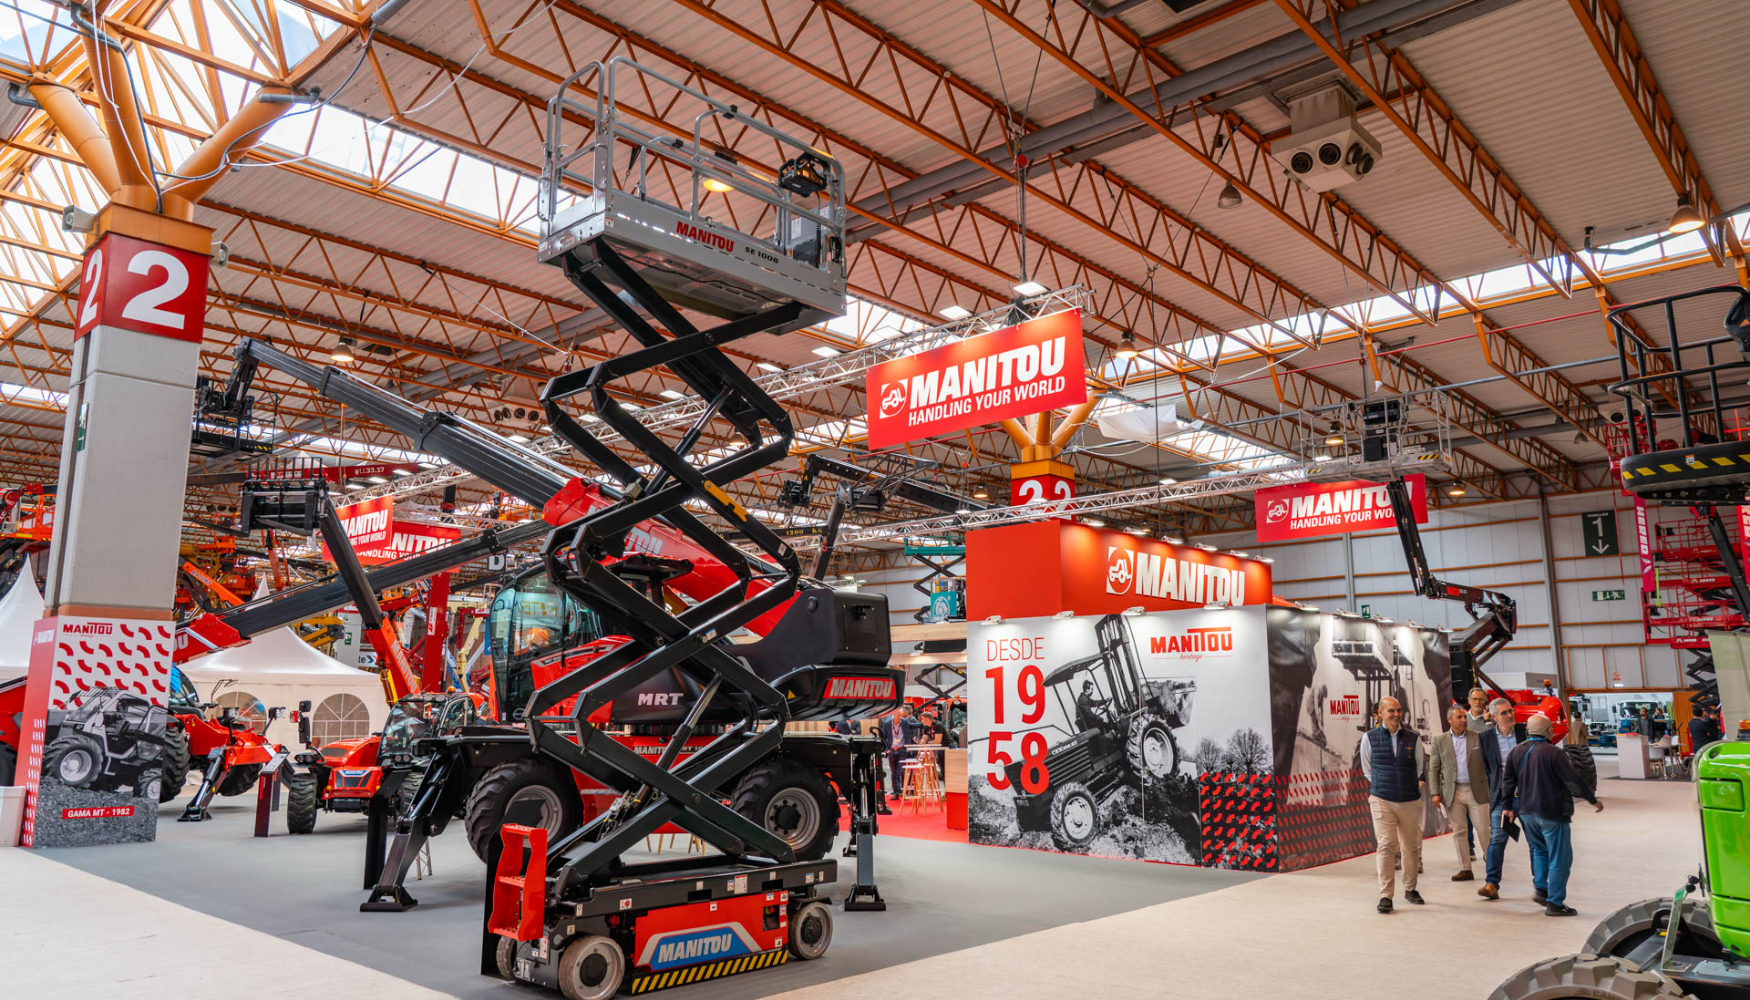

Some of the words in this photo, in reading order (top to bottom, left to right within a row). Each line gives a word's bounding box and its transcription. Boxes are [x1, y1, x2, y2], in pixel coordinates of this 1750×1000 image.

[676, 221, 734, 253] MANITOU
[745, 246, 756, 256] SE
[757, 251, 779, 264] 1008
[80, 249, 103, 329] 2
[121, 250, 190, 330] 2
[909, 336, 1066, 410] MANITOU
[908, 397, 972, 427] HANDLING
[975, 389, 1011, 411] YOUR
[1014, 376, 1066, 401] WORLD
[1290, 513, 1342, 530] HANDLING
[1344, 511, 1372, 523] YOUR
[1592, 517, 1603, 537] 1
[1636, 506, 1649, 555] HERED
[1135, 552, 1245, 607] MANITOU
[63, 622, 113, 635] MANITOU
[1150, 627, 1233, 654] MANITOU
[987, 637, 1045, 662] DESDE
[637, 693, 684, 706] MRT
[829, 679, 894, 698] MANITOU
[985, 665, 1046, 724] 19
[1330, 694, 1360, 715] MANITOU
[633, 746, 668, 755] MANIT
[987, 731, 1050, 794] 58
[67, 810, 91, 818] GAMA
[92, 808, 105, 817] MT
[112, 808, 130, 816] 1982
[658, 933, 733, 964] MANITOU
